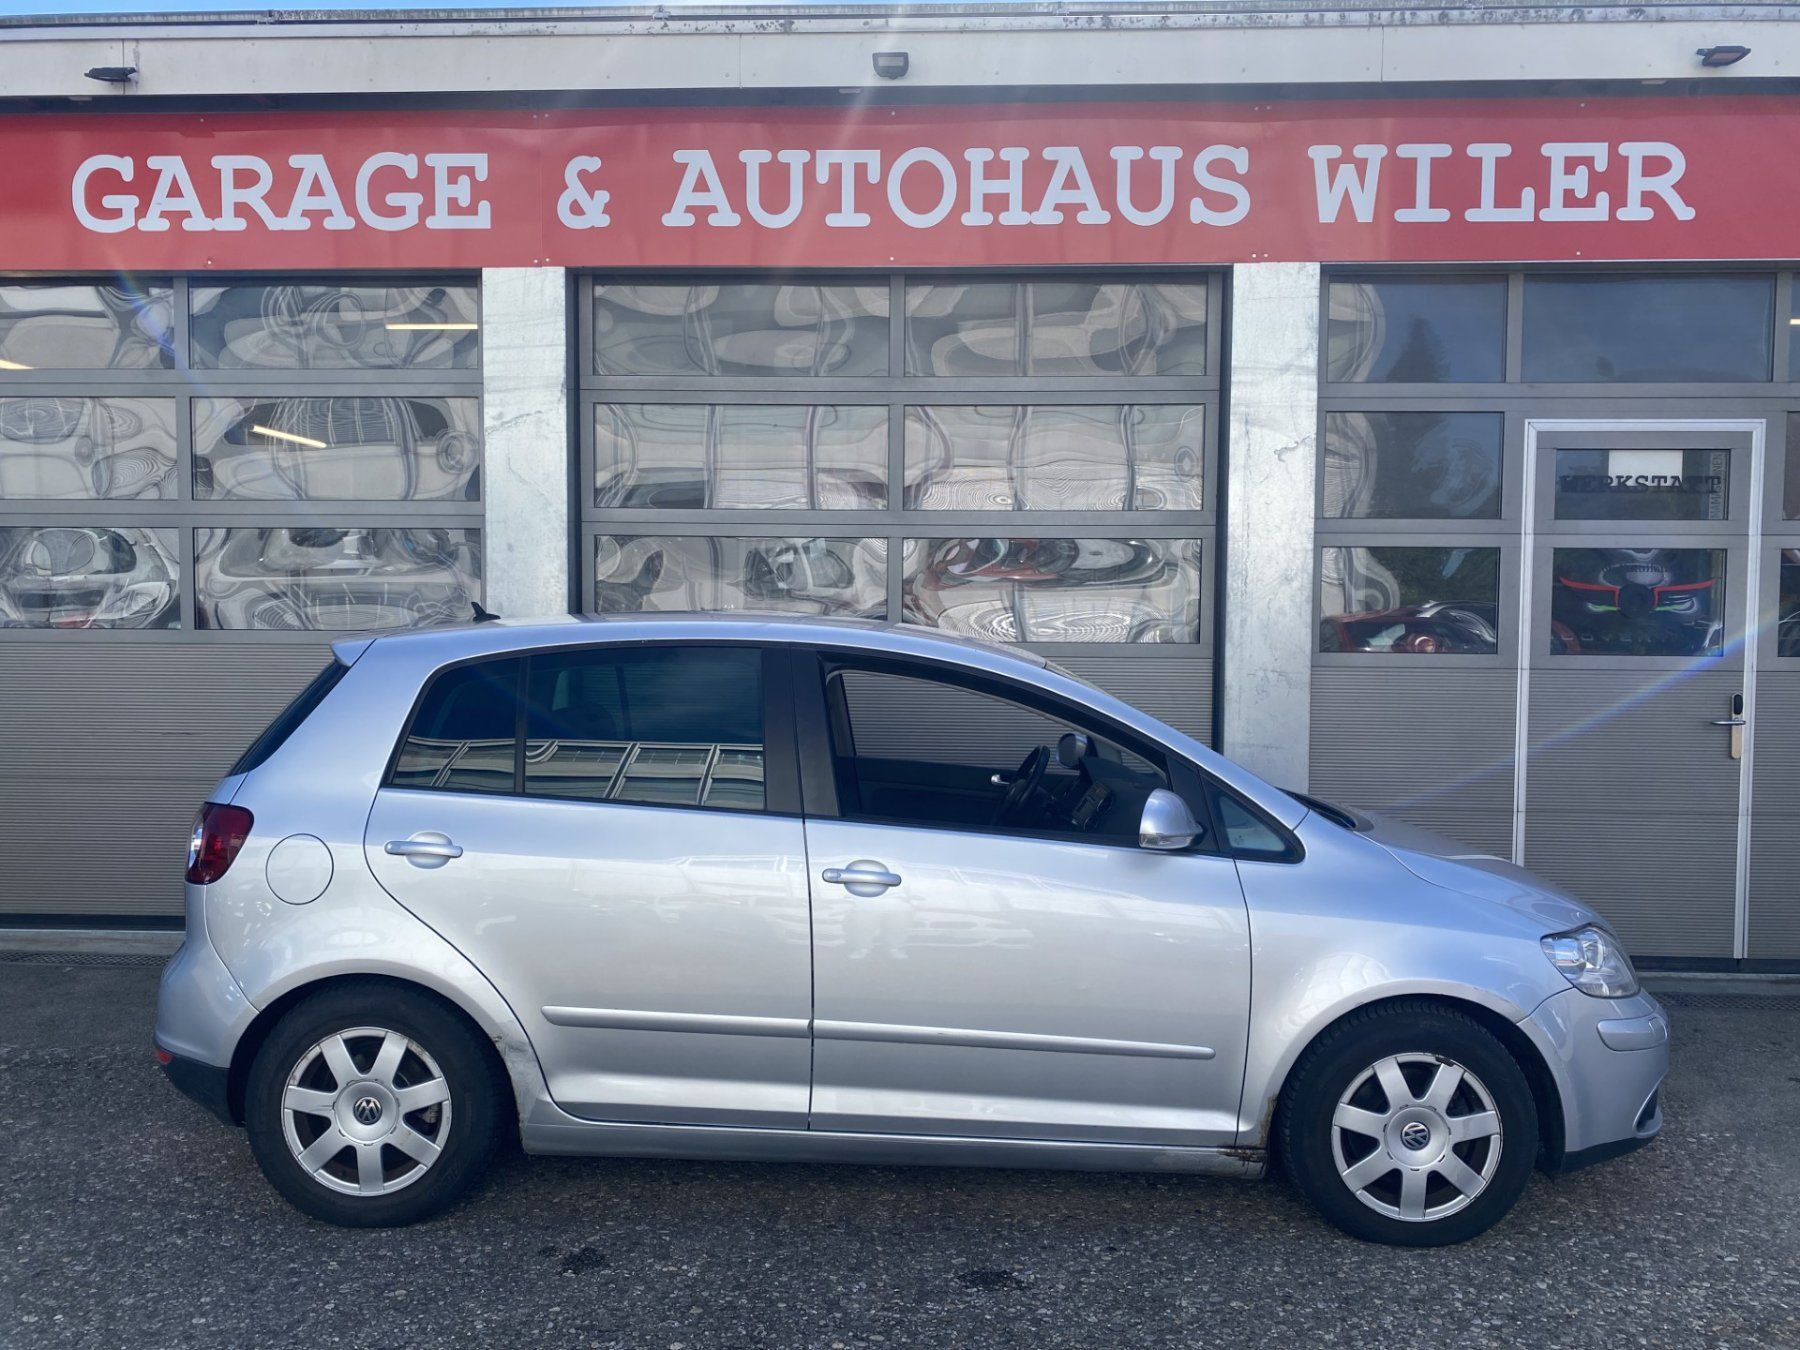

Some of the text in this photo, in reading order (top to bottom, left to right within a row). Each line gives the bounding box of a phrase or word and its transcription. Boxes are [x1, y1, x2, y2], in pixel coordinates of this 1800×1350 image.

[72, 142, 1696, 233] GARAGE & AUTOHAUS WILER
[1558, 475, 1722, 493] WERKSTATT
